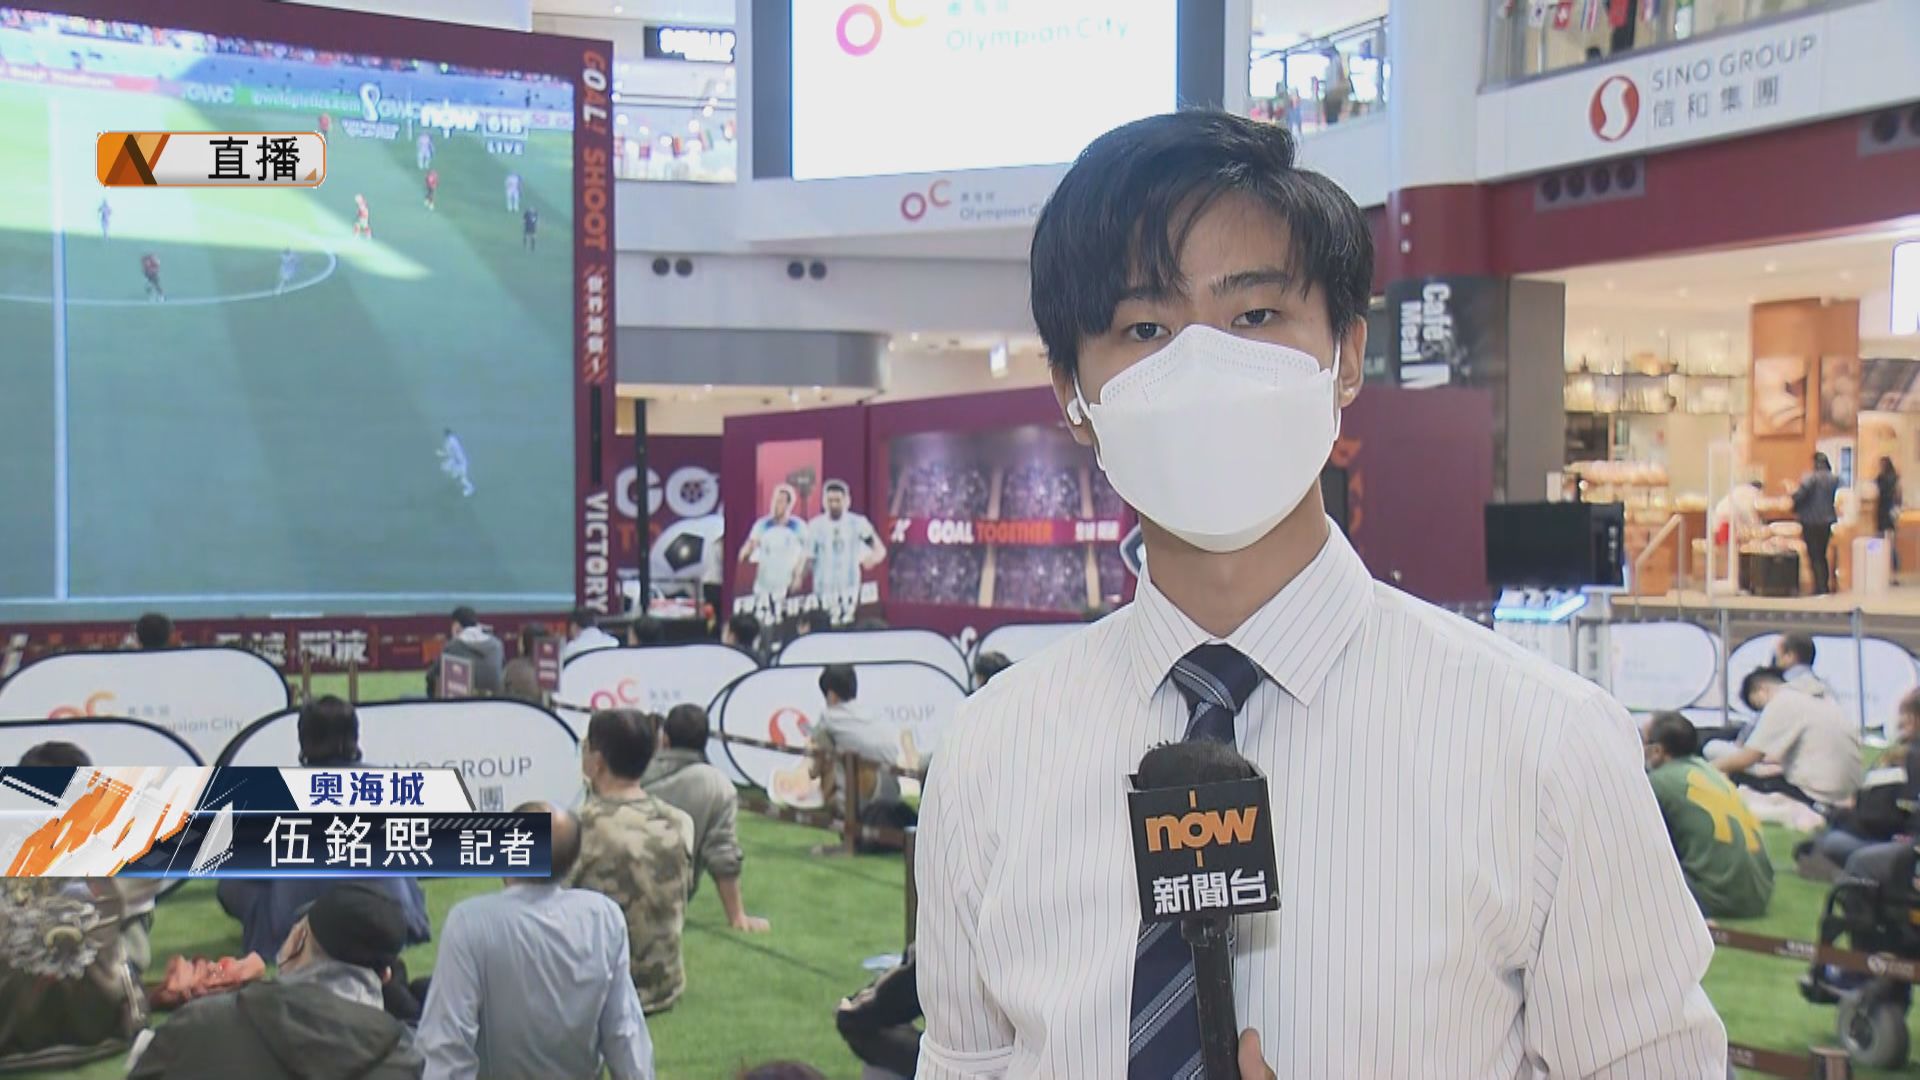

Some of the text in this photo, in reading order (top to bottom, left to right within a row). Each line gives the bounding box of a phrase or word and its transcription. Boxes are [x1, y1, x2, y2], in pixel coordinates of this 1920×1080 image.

[945, 16, 1130, 51] Olympian City
[1652, 34, 1818, 92] SINO GROUP
[582, 50, 607, 135] GOAL!
[1652, 75, 1780, 129] 信和集團
[487, 140, 525, 156] LIVE
[582, 147, 607, 251] SHOOT
[1400, 300, 1422, 362] Meal
[1422, 282, 1453, 341] Café
[584, 492, 609, 613] VICTORY
[927, 518, 975, 545] GOAL
[977, 519, 1055, 544] TOGETHER
[1145, 806, 1259, 852] now
[1152, 868, 1268, 916] 新聞台
